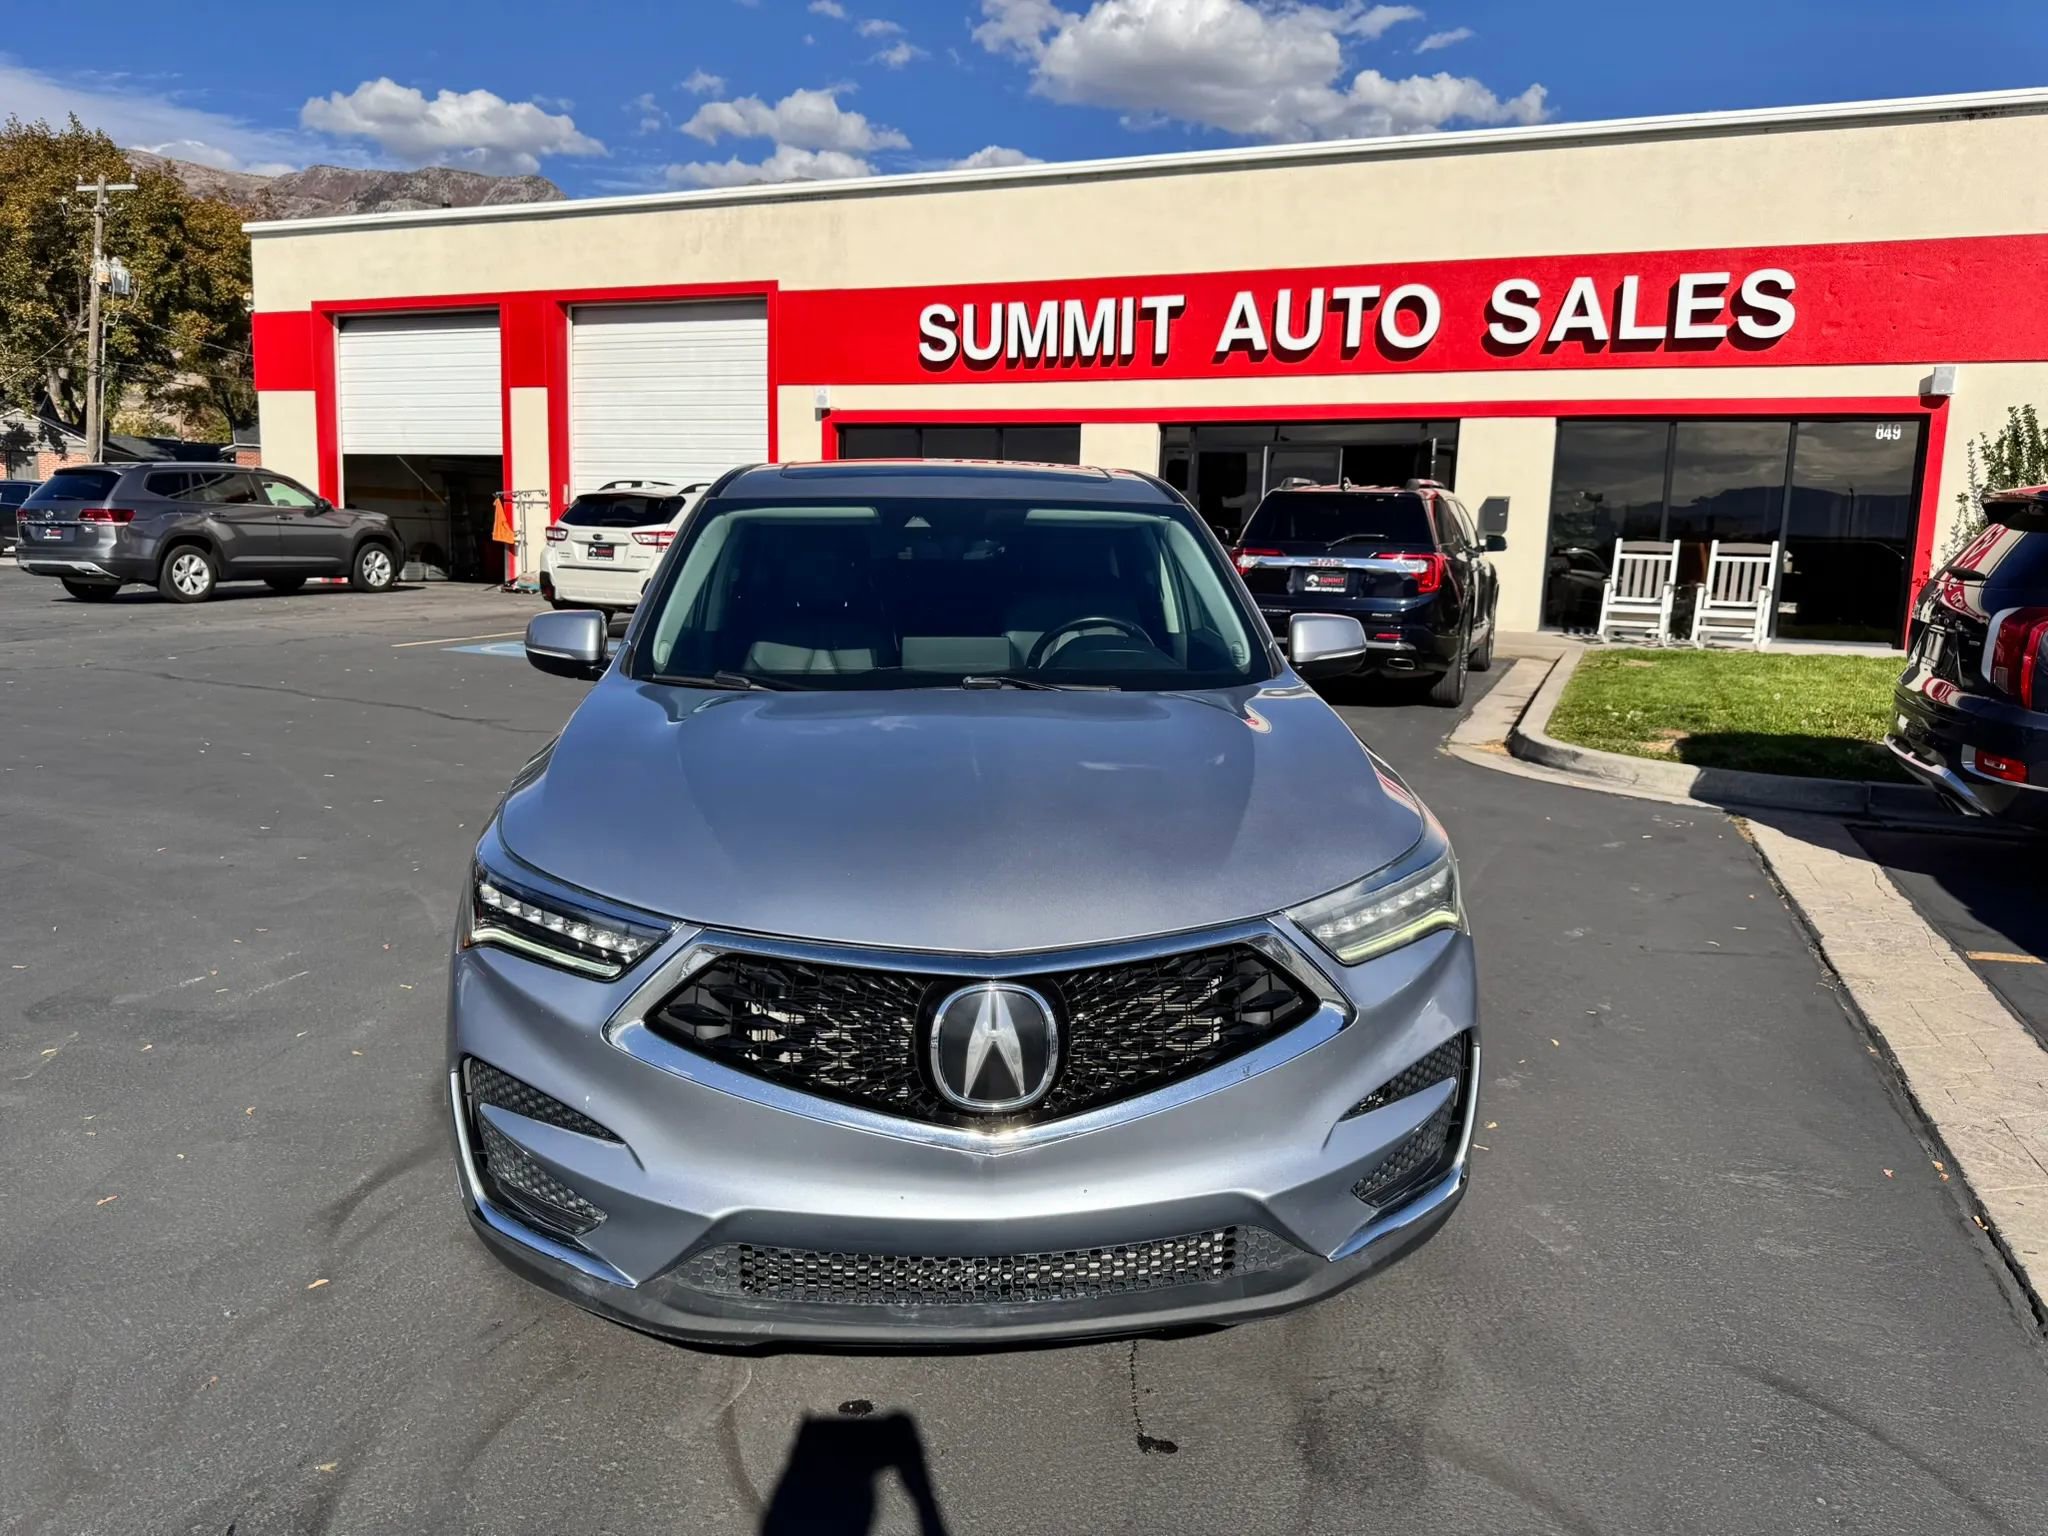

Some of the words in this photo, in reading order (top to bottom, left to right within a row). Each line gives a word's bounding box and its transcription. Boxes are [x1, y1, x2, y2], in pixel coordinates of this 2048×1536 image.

[918, 295, 1186, 363] SUMMIT
[1215, 283, 1442, 354] AUTO
[1488, 268, 1797, 346] SALES
